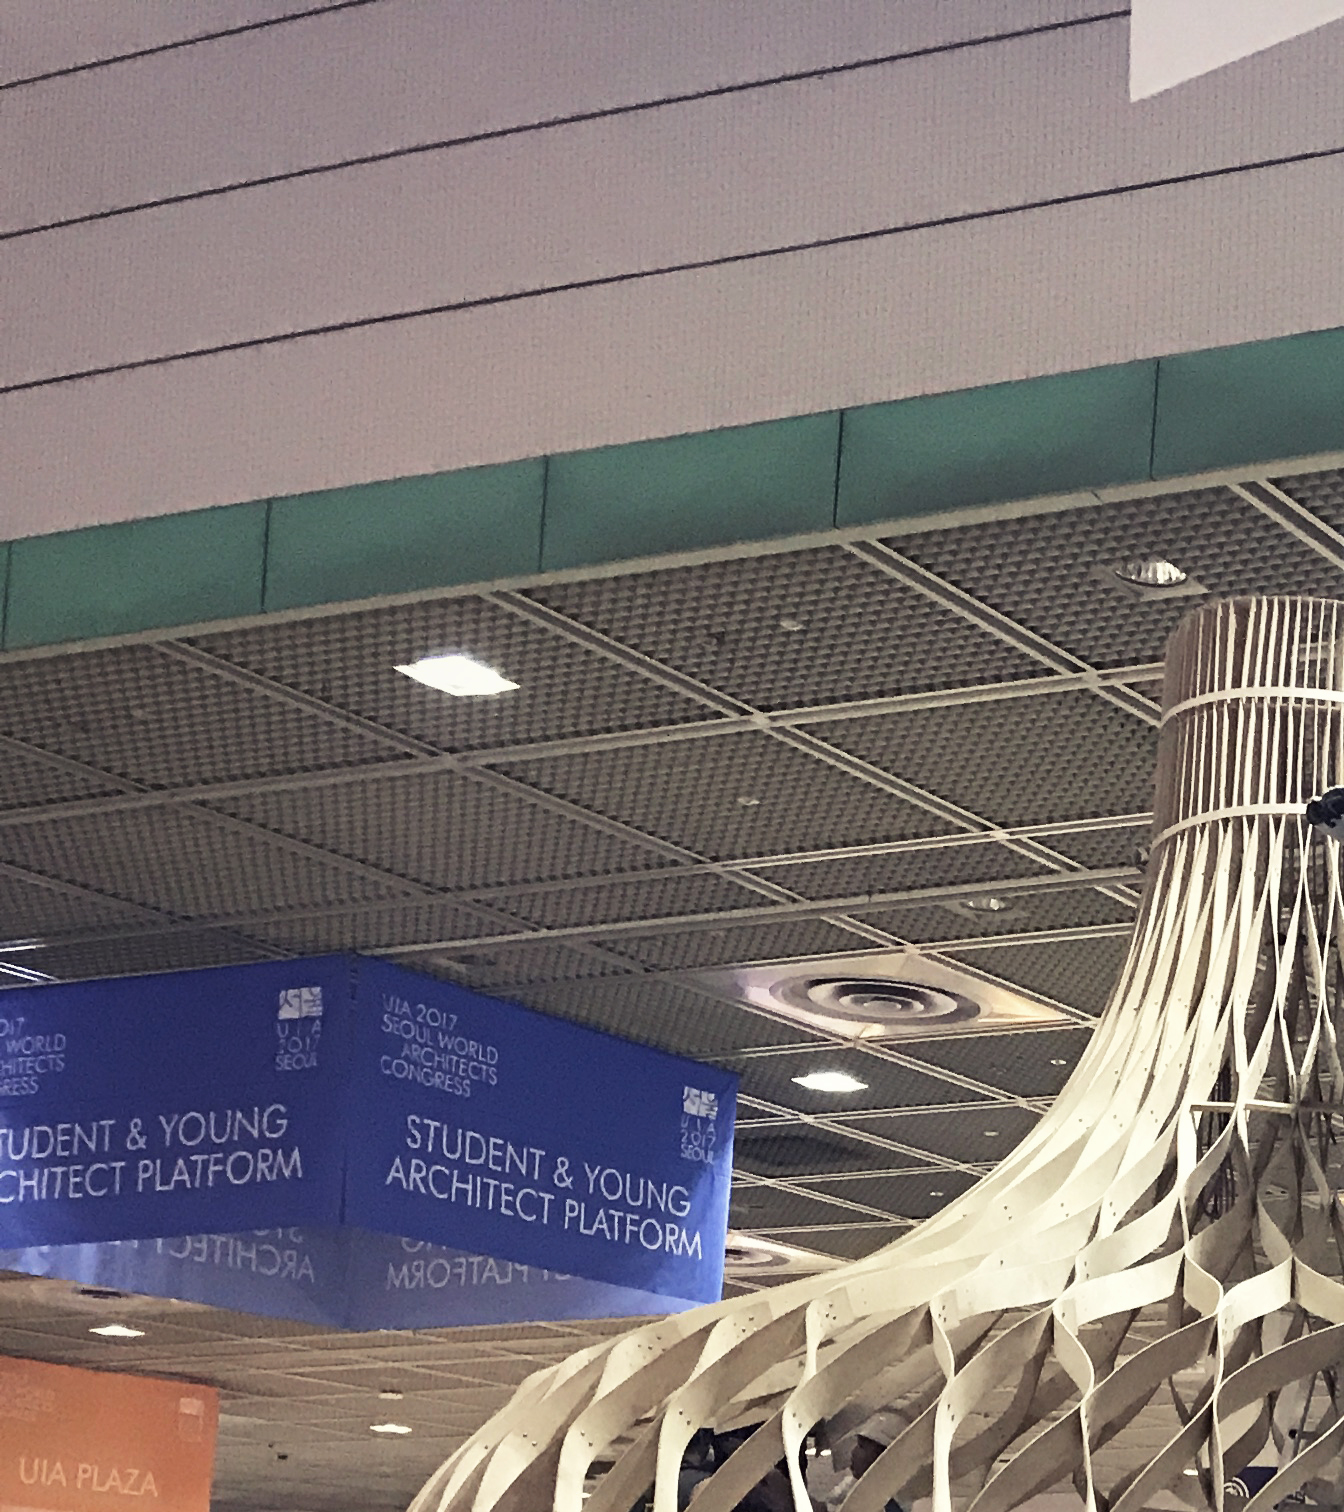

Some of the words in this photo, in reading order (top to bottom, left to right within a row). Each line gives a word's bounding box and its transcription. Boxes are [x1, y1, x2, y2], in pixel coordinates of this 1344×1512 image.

[382, 993, 413, 1019] UIA
[416, 1003, 458, 1031] 2017
[6, 1033, 66, 1054] WORLD
[381, 1014, 434, 1046] SEOUL
[437, 1031, 499, 1064] WORLD
[0, 1054, 65, 1076] HITECTS
[380, 1055, 471, 1098] CONGRESS
[401, 1043, 498, 1086] ARCHITECTS
[126, 1118, 147, 1151] &
[158, 1104, 288, 1148] YOUNG
[0, 1161, 126, 1203] CHITECT
[136, 1147, 303, 1193] PLATFORM
[406, 1114, 545, 1180] STUDENT
[553, 1157, 573, 1189] &
[584, 1162, 691, 1217] YOUNG
[385, 1155, 554, 1224] ARCHITECT
[564, 1199, 703, 1261] PLATFORM
[20, 1457, 66, 1488] UIA
[76, 1463, 158, 1498] PLAZA
